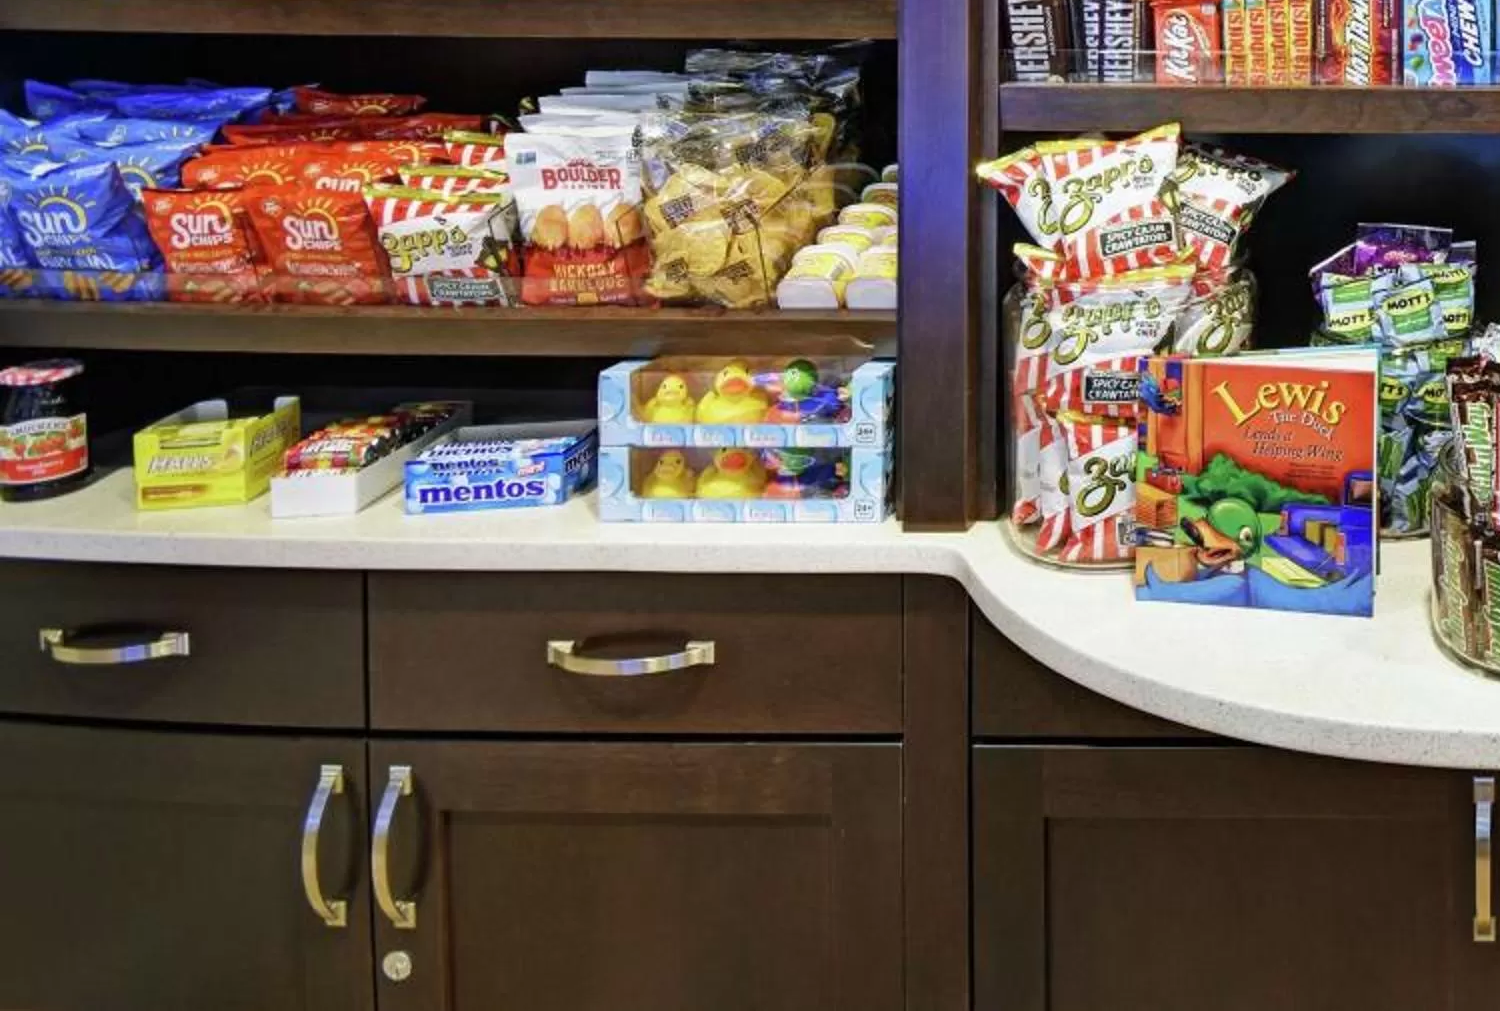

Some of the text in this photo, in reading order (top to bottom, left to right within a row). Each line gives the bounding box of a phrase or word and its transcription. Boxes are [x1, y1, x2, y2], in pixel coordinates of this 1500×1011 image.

[1345, 45, 1370, 86] HOT
[541, 167, 623, 190] BOULDER
[171, 211, 233, 249] Sun
[282, 214, 338, 251] Sun
[1212, 380, 1347, 427] Lewis
[1306, 444, 1345, 462] Wing
[418, 479, 546, 505] mentos
